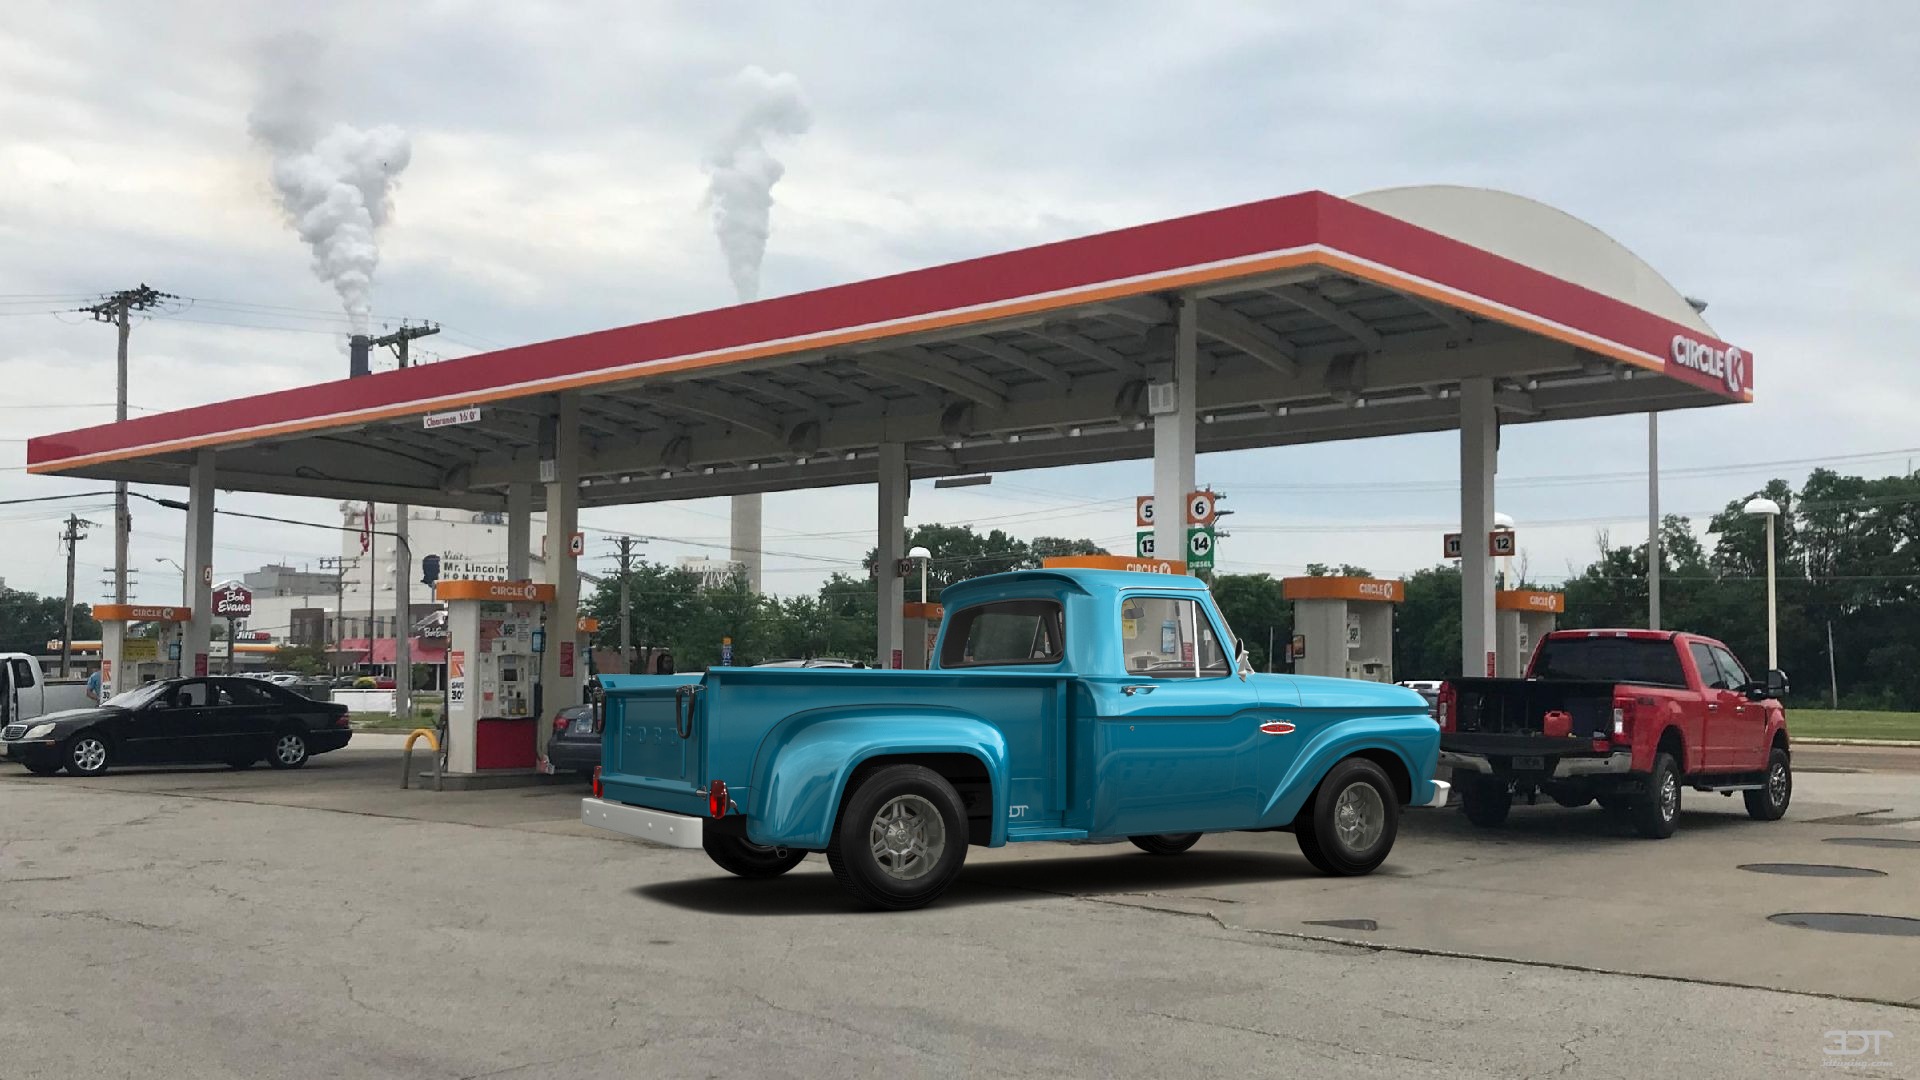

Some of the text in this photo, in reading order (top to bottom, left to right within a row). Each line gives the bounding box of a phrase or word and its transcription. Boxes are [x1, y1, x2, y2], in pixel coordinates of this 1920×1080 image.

[1671, 334, 1744, 392] CIRCLE K
[426, 416, 456, 427] Clearance
[1144, 505, 1153, 518] 5
[1195, 501, 1205, 515] 6
[572, 540, 579, 549] 4
[1141, 540, 1154, 553] 13
[1193, 537, 1209, 551] 14
[1496, 538, 1509, 549] 12
[444, 562, 508, 573] Mr. Lincoln'
[901, 564, 910, 572] 10
[1126, 563, 1158, 574] CIRCLE
[444, 572, 507, 581] HOMETOW
[490, 584, 537, 600] CIRCLE K
[1360, 584, 1384, 594] CIRCLE
[224, 591, 245, 601] Bob
[1530, 596, 1548, 606] CIRCLE
[218, 600, 251, 612] Evans
[132, 608, 174, 619] CIRCLE K
